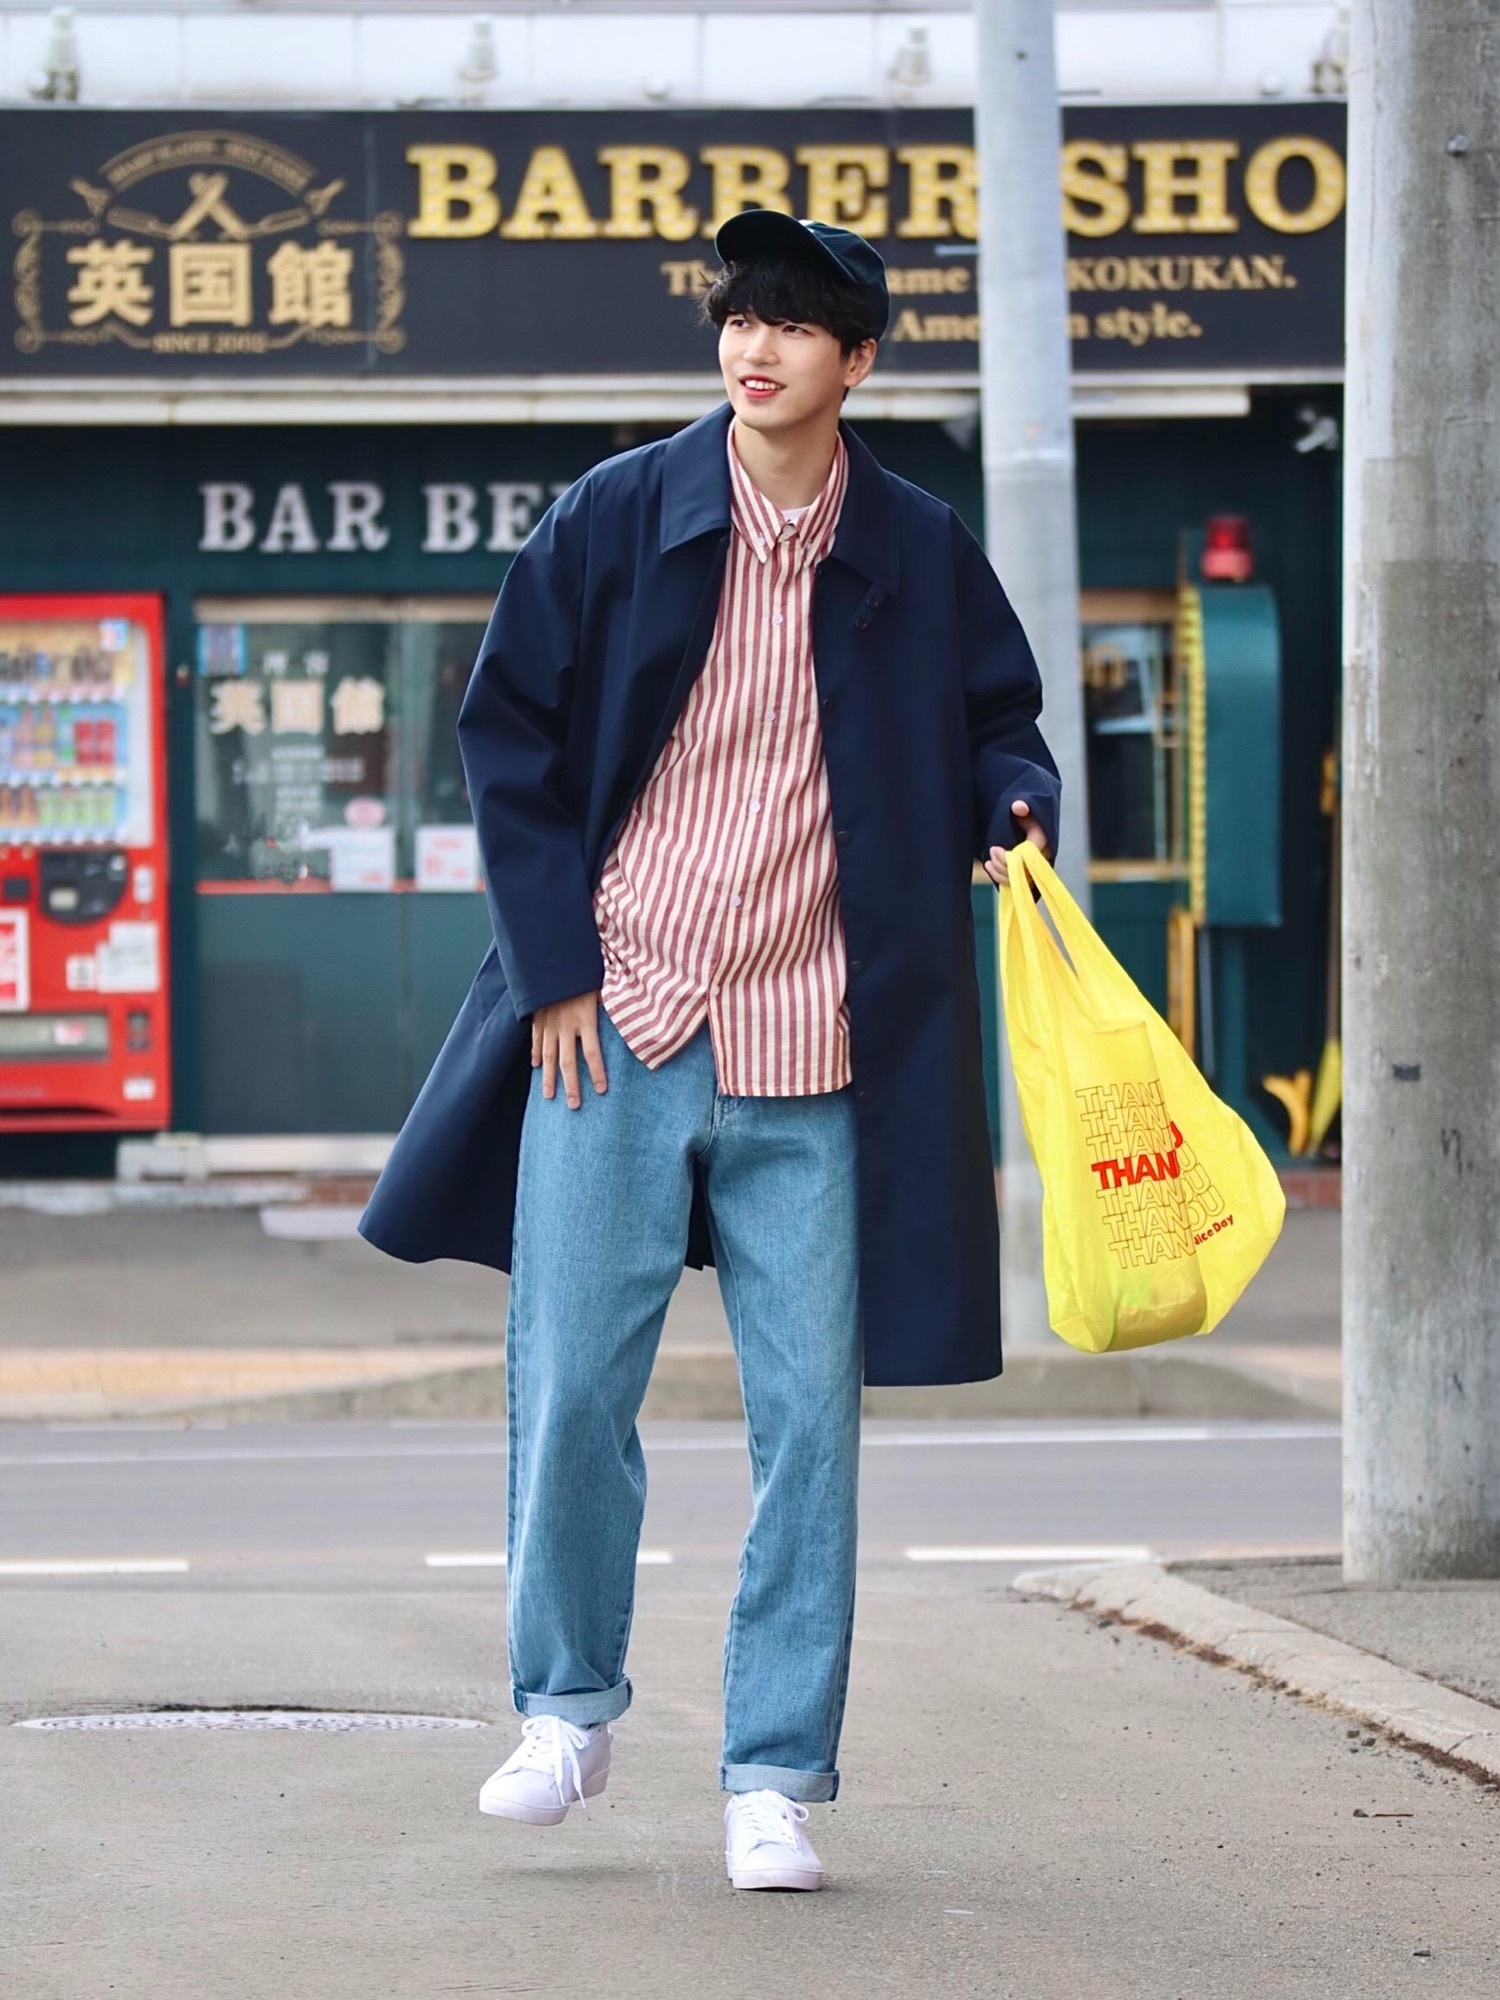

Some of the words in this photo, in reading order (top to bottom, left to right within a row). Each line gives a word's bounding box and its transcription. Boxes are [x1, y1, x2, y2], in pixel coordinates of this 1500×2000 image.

[405, 144, 980, 241] BARBER
[66, 240, 352, 327] 英国館
[1095, 302, 1203, 346] style.
[200, 482, 390, 553] BAR
[421, 482, 570, 553] BE
[1091, 1150, 1180, 1190] THAN
